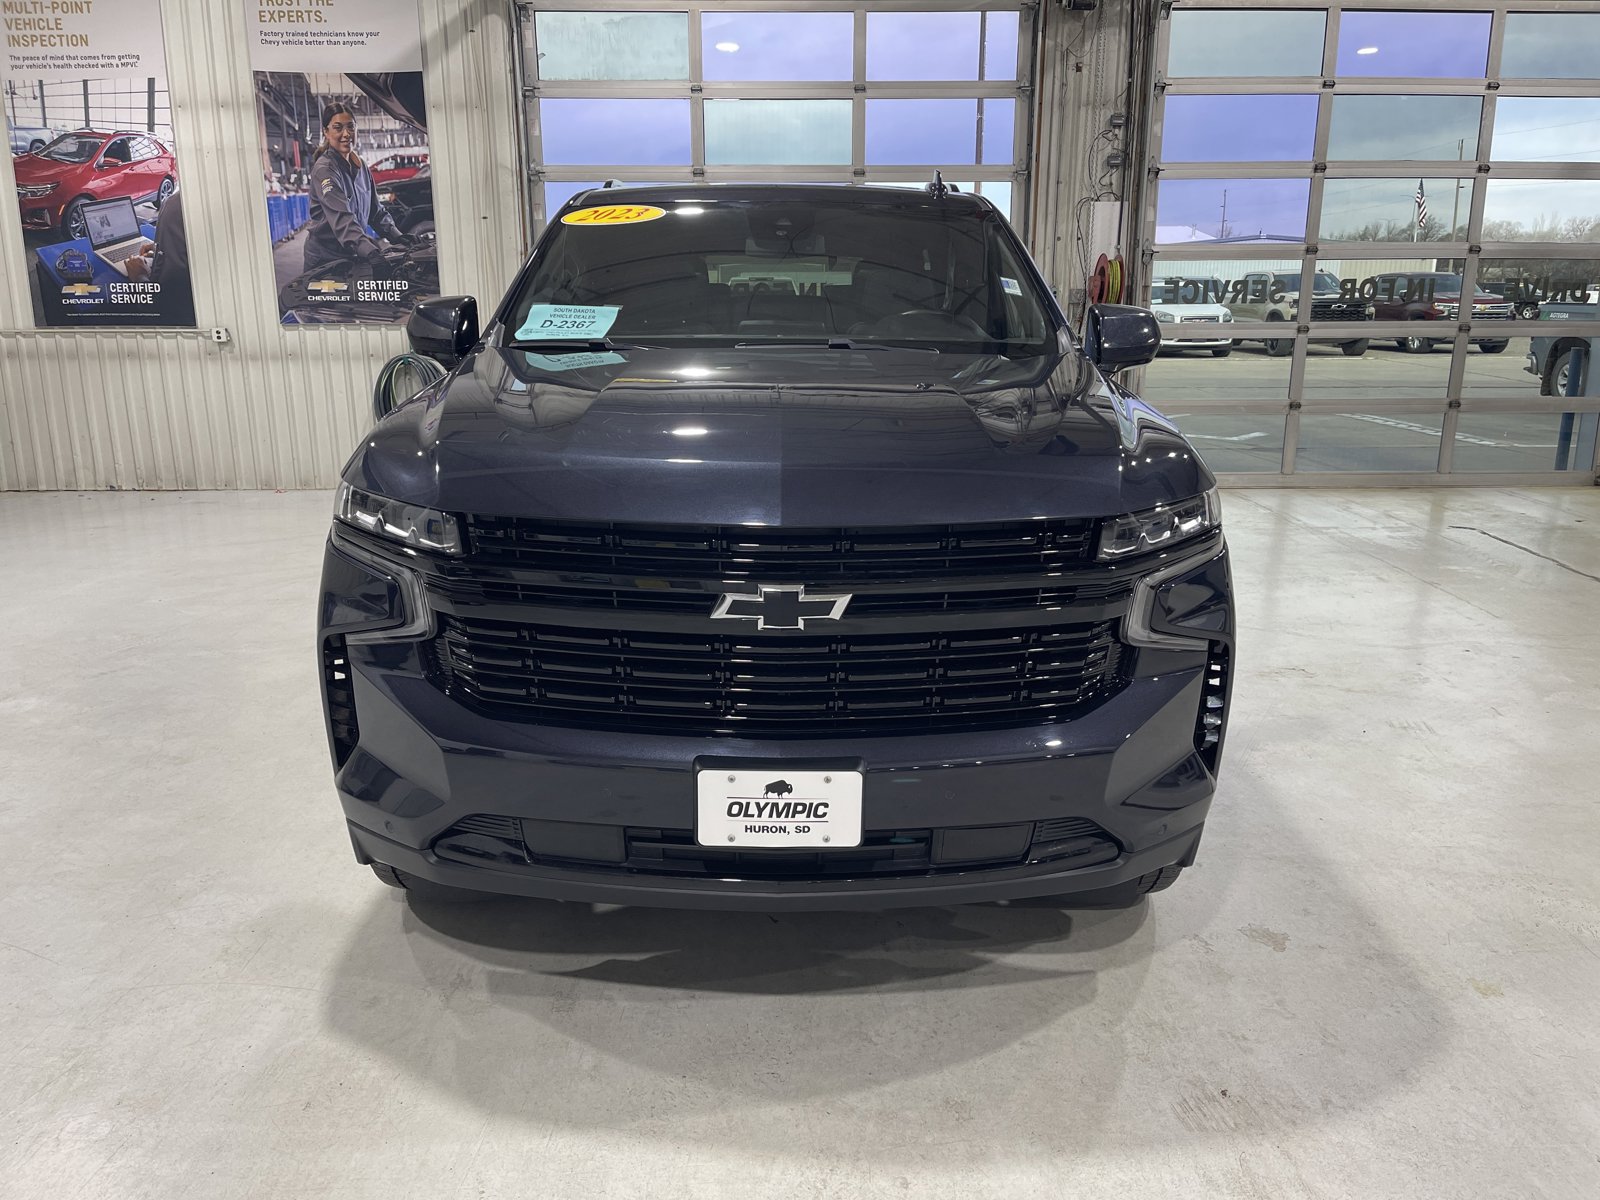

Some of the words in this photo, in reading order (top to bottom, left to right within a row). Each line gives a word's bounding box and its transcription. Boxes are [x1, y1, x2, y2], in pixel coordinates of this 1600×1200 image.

[3, 1, 93, 14] MULTI-POINT
[258, 9, 328, 23] EXPERTS.
[5, 18, 63, 31] VEHICLE
[259, 30, 284, 38] Factory
[7, 34, 89, 47] INSPECTION
[260, 38, 280, 46] Chevy
[342, 39, 367, 47] anyone.
[22, 55, 40, 63] peace
[117, 53, 140, 62] getting
[10, 63, 25, 71] your
[25, 62, 52, 70] vehicle's
[574, 208, 650, 222] 2023
[109, 282, 161, 293] CERTIFIED
[357, 280, 409, 291] CERTIFIED
[111, 293, 154, 304] SERVICE
[357, 291, 401, 302] SERVICE
[540, 319, 597, 329] D-2367
[726, 801, 829, 819] OLYMPIC
[744, 825, 790, 835] HURON,
[794, 825, 811, 834] SD
